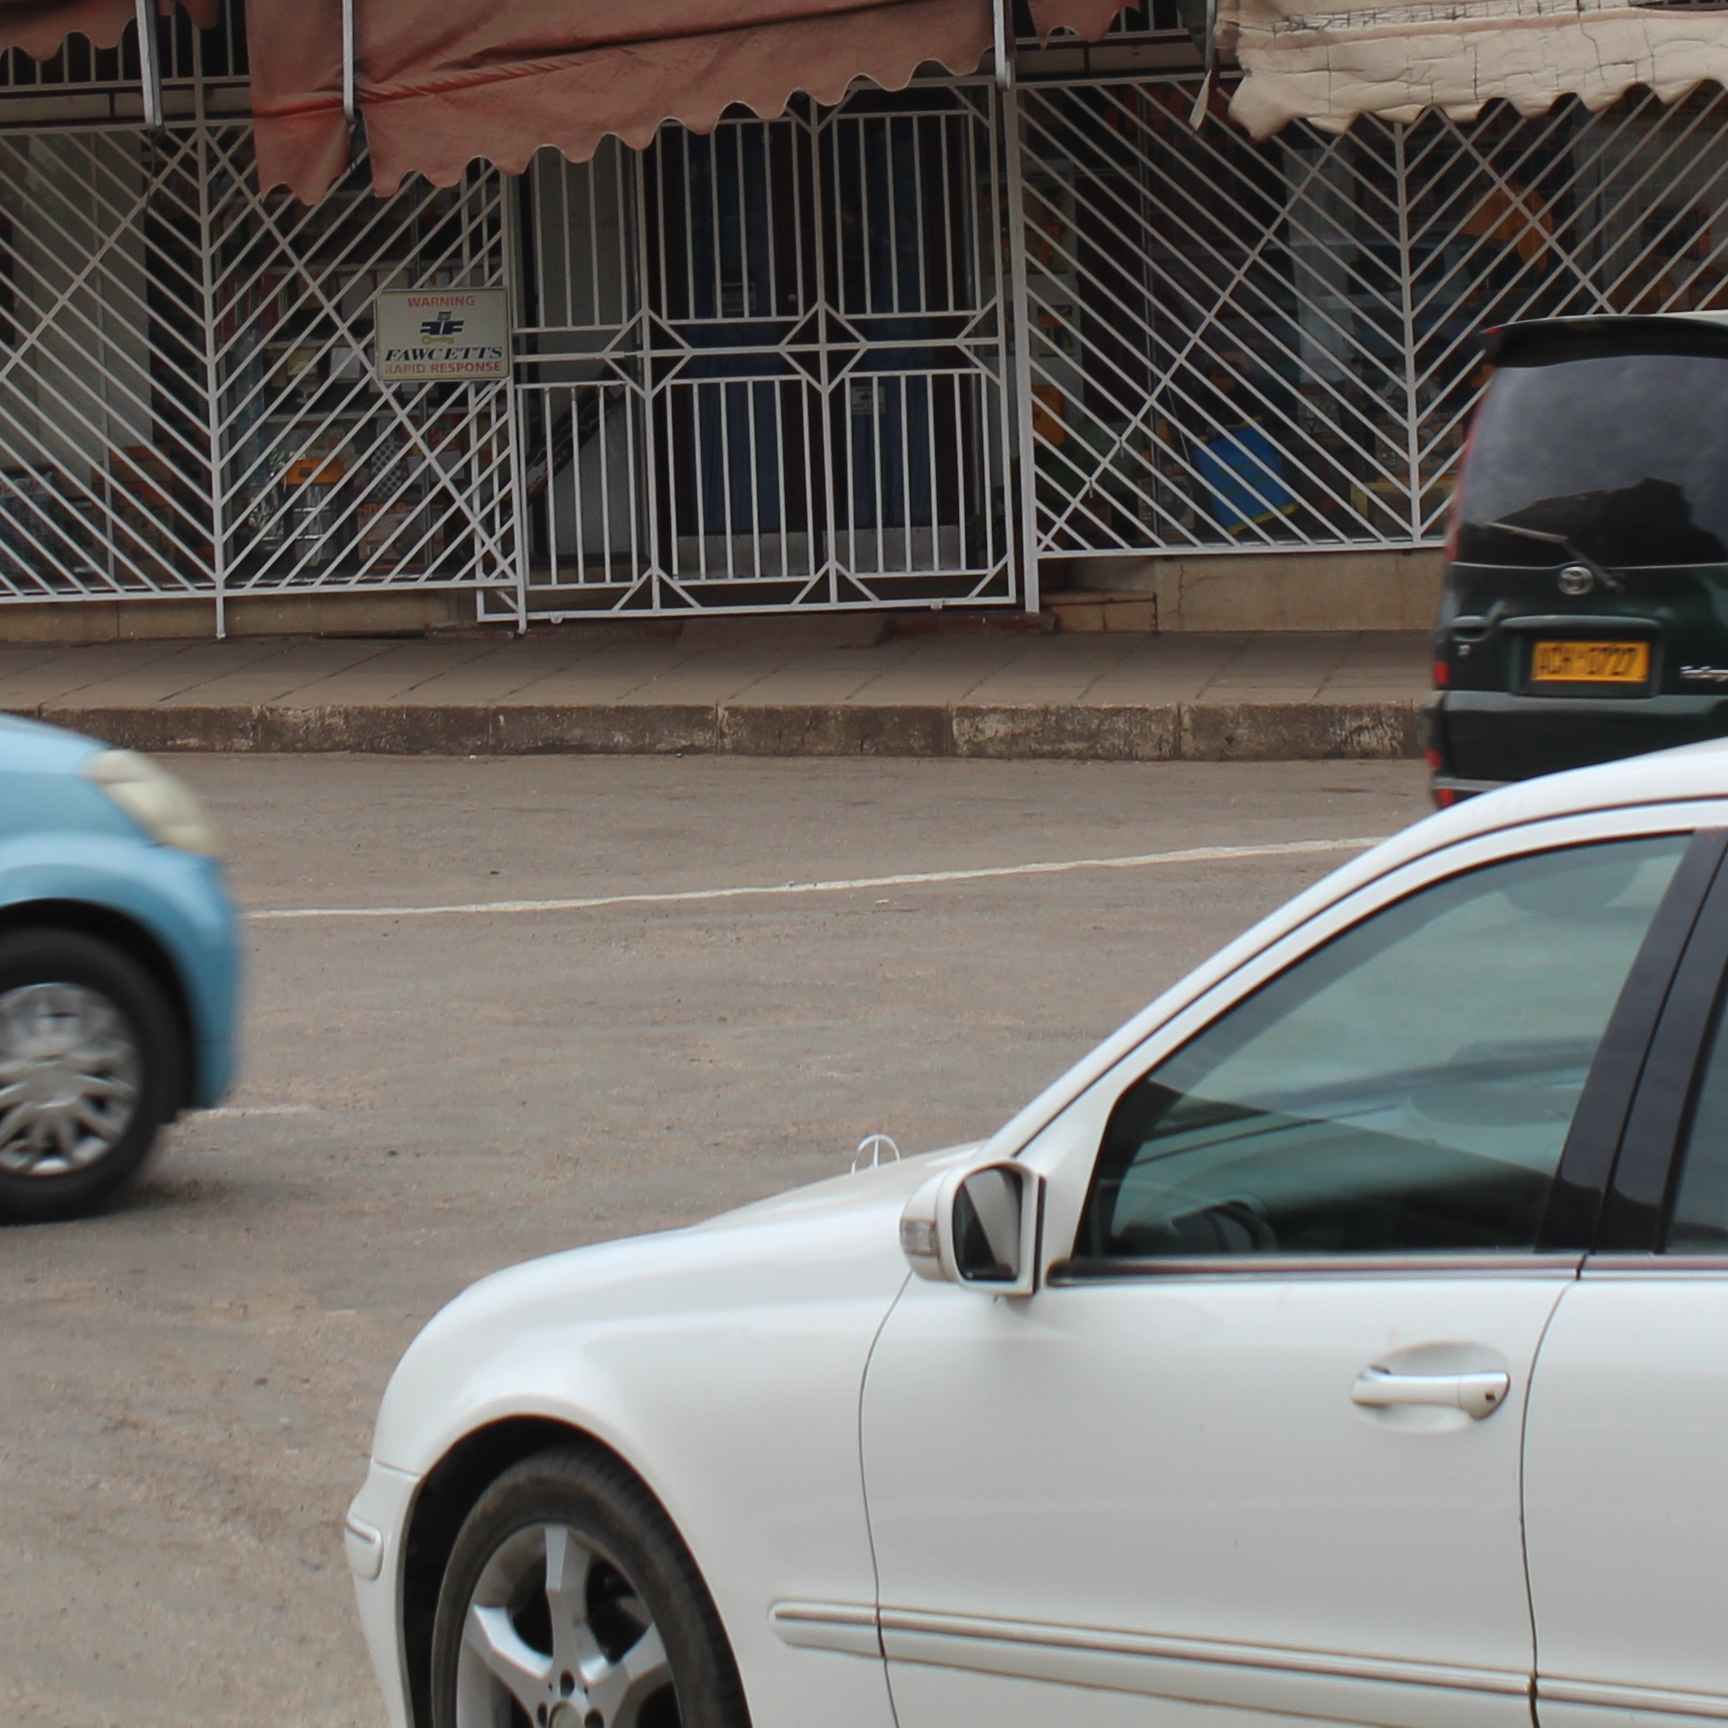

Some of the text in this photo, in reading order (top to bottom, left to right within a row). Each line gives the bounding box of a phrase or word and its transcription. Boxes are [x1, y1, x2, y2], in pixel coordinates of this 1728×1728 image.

[407, 295, 476, 308] WARNING
[384, 345, 503, 362] FAWCETTS
[384, 361, 502, 376] RAPID RESPONSE
